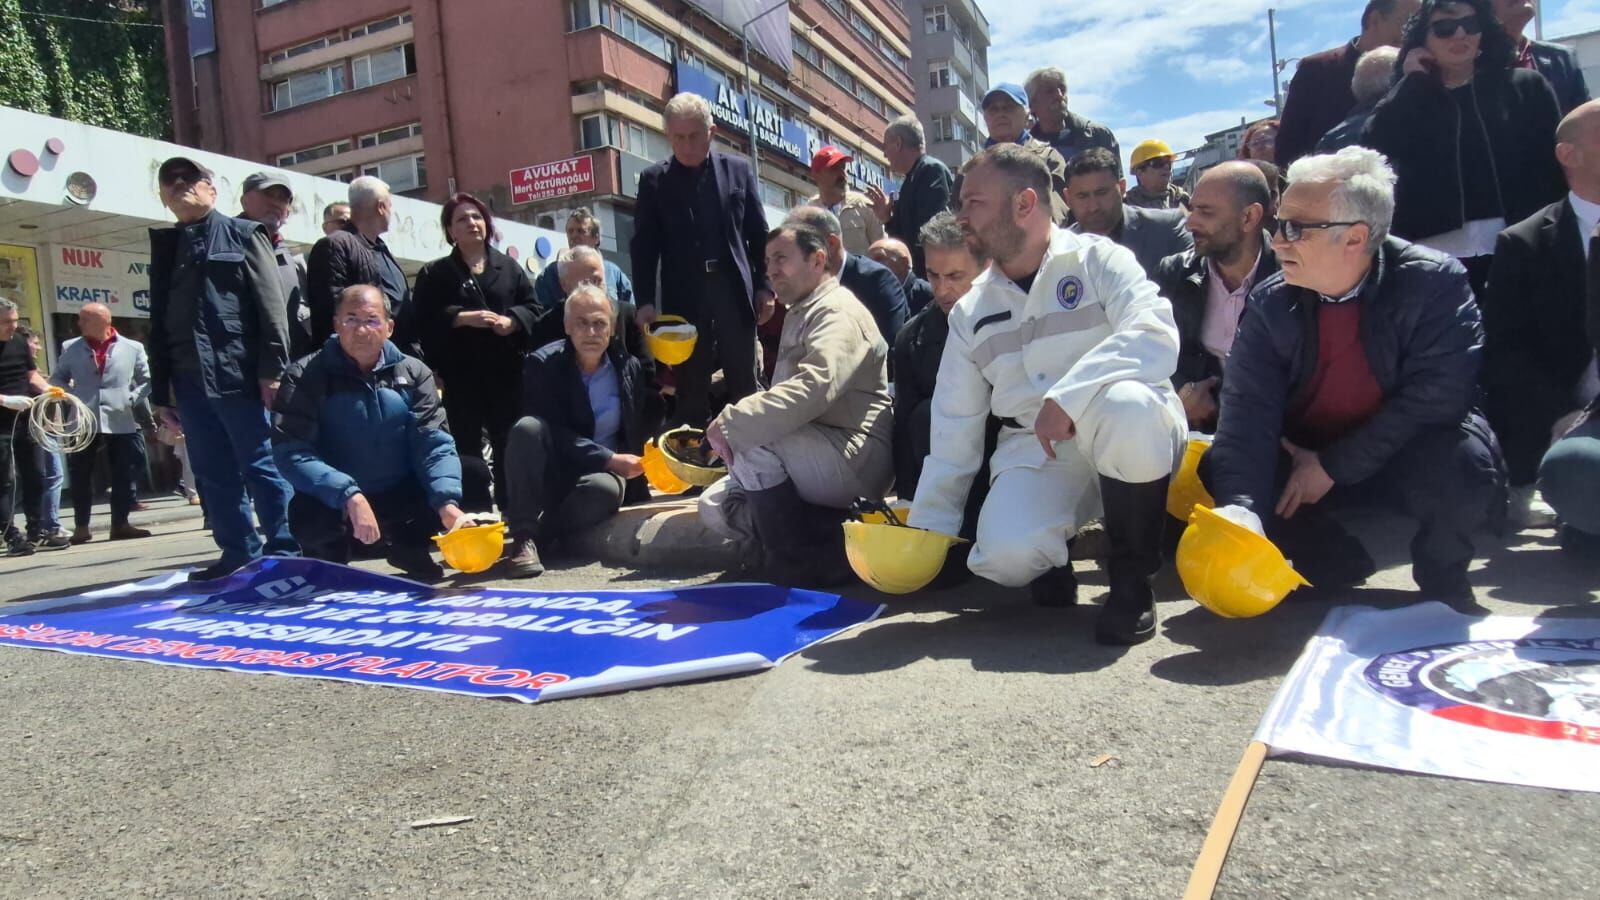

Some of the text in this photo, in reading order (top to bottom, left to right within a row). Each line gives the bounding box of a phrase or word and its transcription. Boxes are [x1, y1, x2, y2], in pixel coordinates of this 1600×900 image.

[717, 84, 741, 115] AK
[709, 100, 750, 133] NGULDAK
[523, 160, 578, 180] AVUKAT
[534, 173, 590, 191] ÖZTÜRKOĞLU
[62, 247, 104, 269] NUK
[56, 285, 111, 303] KRAFT
[414, 594, 637, 616] YANINDA,
[133, 616, 502, 653] KARŞISINDAYIZ
[301, 607, 381, 622] VE
[356, 610, 700, 641] ZORBALIĞIN
[322, 656, 571, 690] PLATFOR
